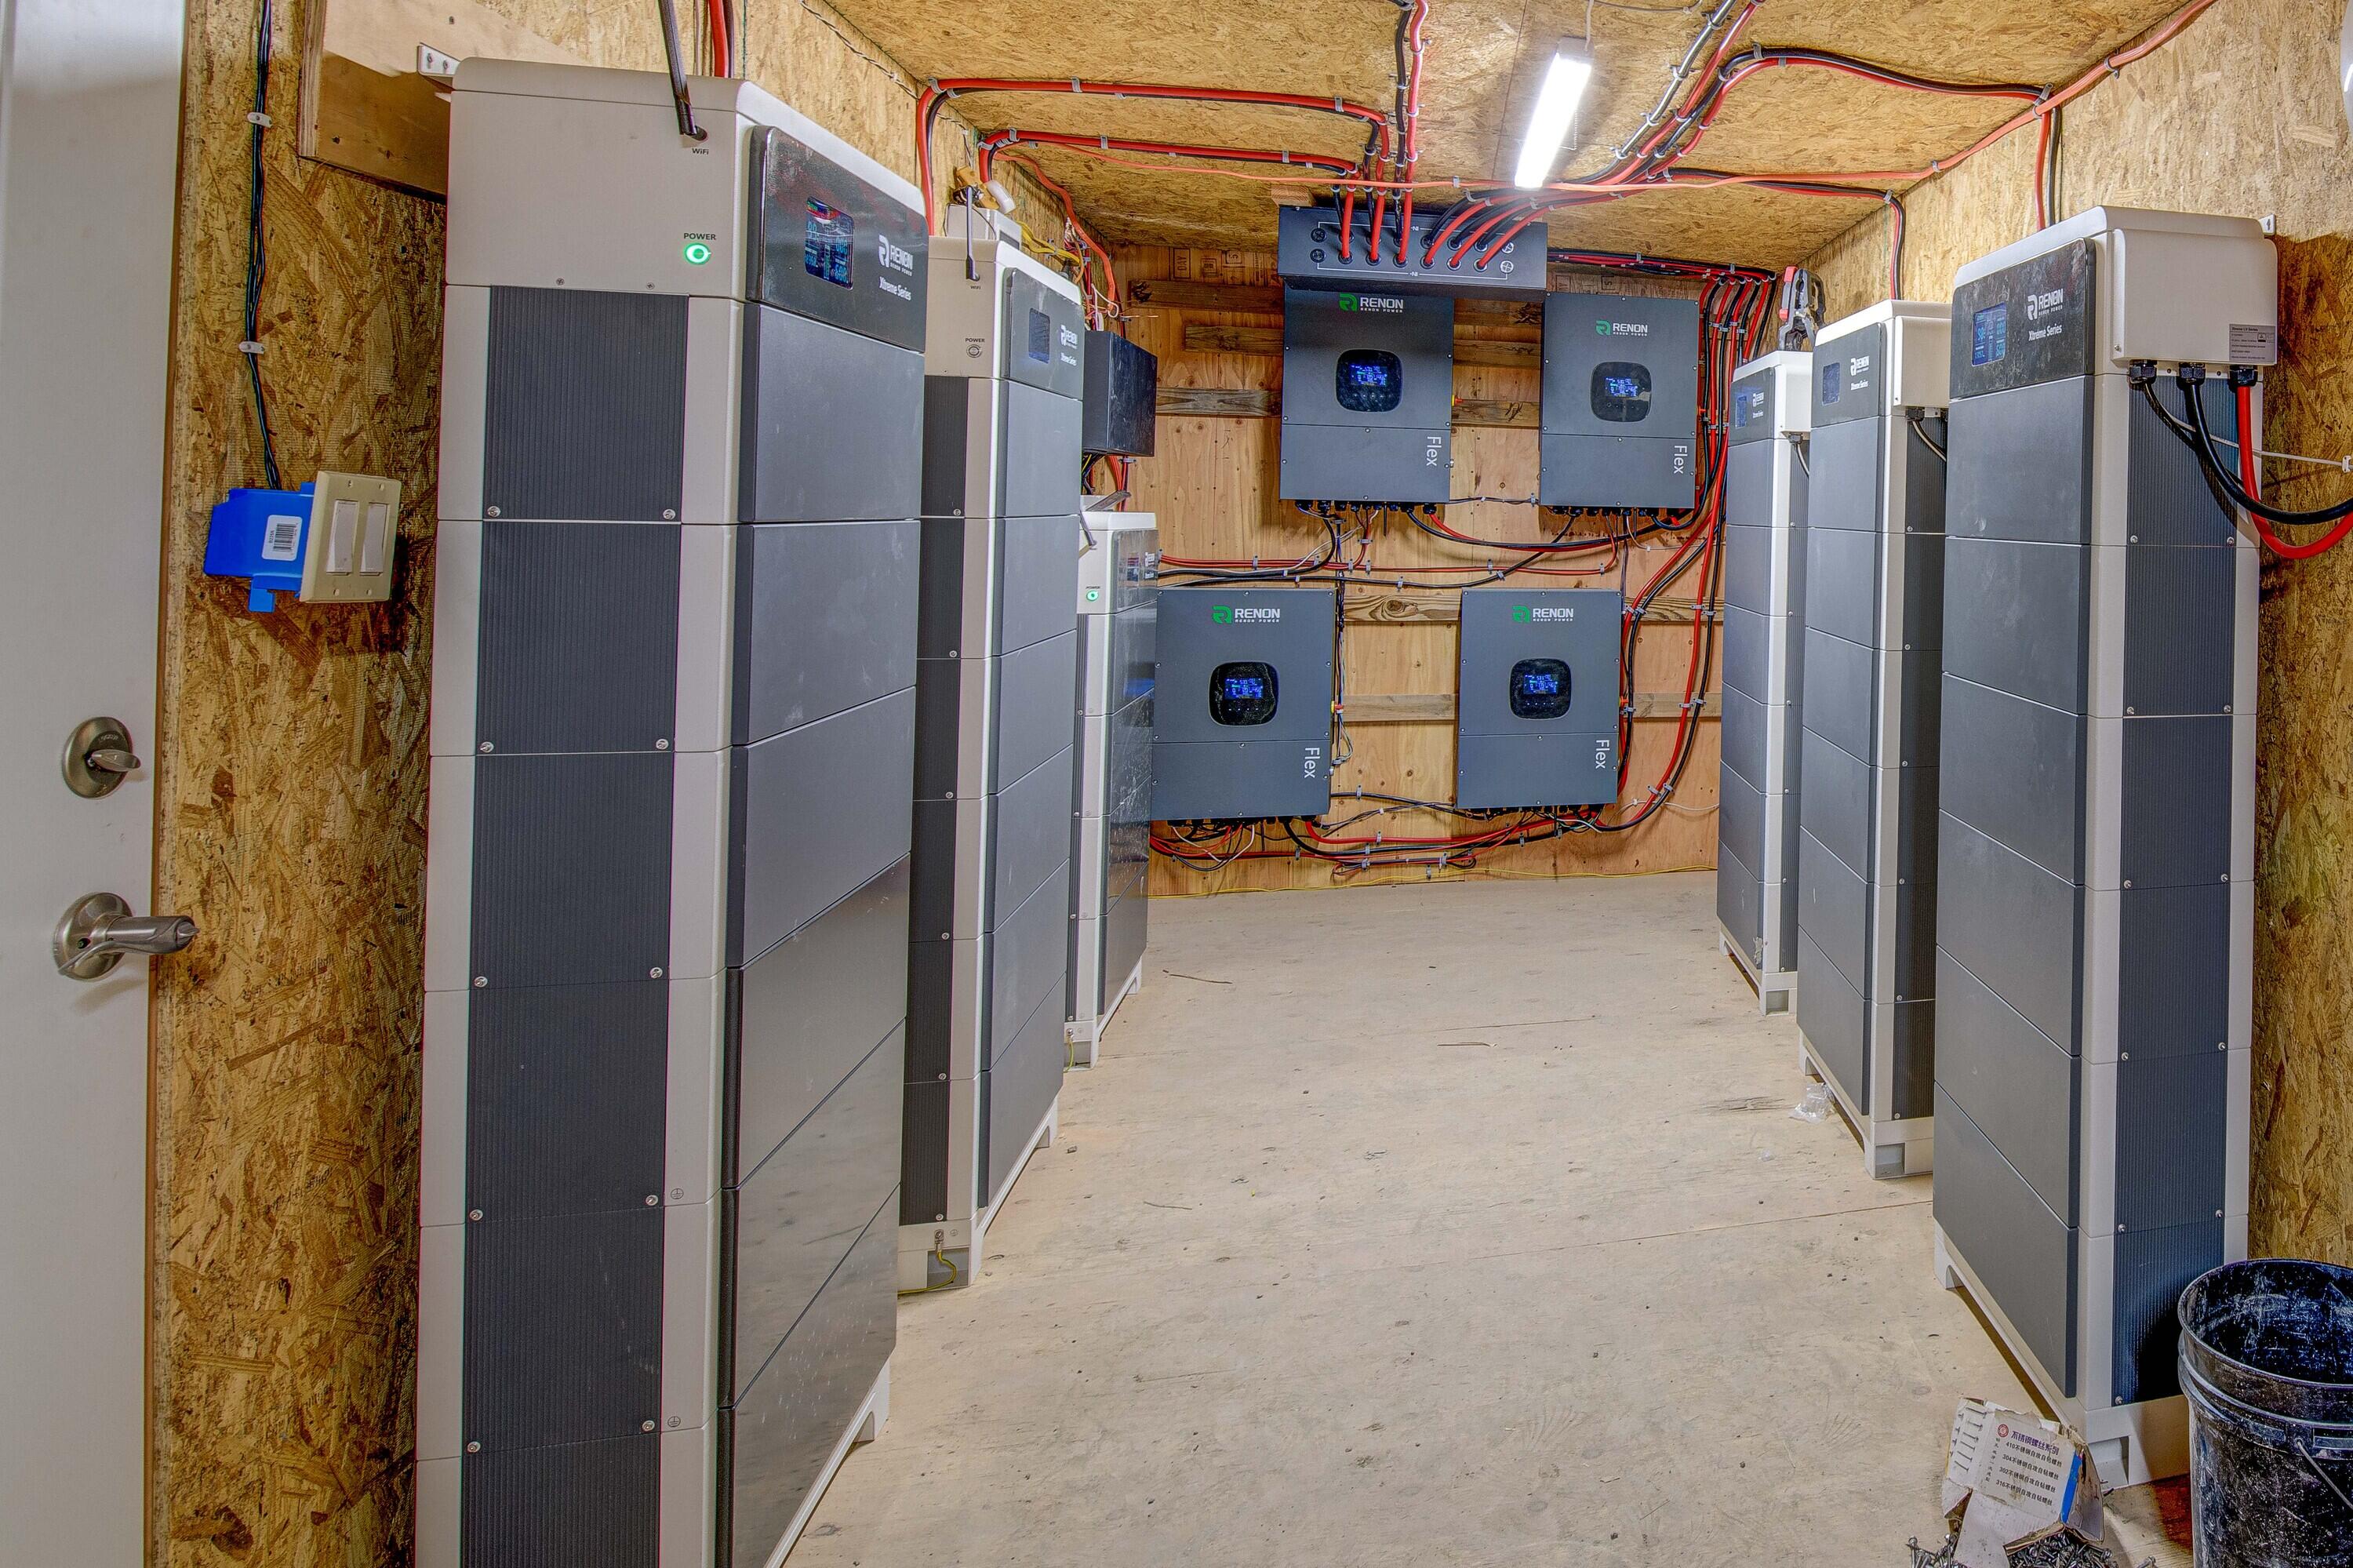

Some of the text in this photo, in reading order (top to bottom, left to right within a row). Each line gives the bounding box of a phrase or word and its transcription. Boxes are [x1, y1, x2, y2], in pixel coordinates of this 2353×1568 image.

[890, 245, 913, 270] RENON
[879, 276, 911, 301] Xtreme Series
[2038, 288, 2063, 309] RENON
[1360, 297, 1404, 309] RENON
[1613, 322, 1648, 333] RENON
[2028, 323, 2063, 341] Xtreme Series
[1427, 436, 1442, 466] Flex
[1674, 446, 1688, 474] Flex
[1235, 608, 1280, 618] RENON
[1533, 608, 1573, 618] RENON
[1304, 748, 1320, 779] Flex
[1595, 740, 1609, 769] Flex
[2011, 1430, 2060, 1456] 不锈钢螺丝系列
[2002, 1454, 2059, 1480] 304不锈钢自攻自钻螺丝
[1995, 1479, 2053, 1506] 316不锈钢自攻自钻螺丝
[1999, 1467, 2056, 1493] 302不锈钢自攻自钻螺丝
